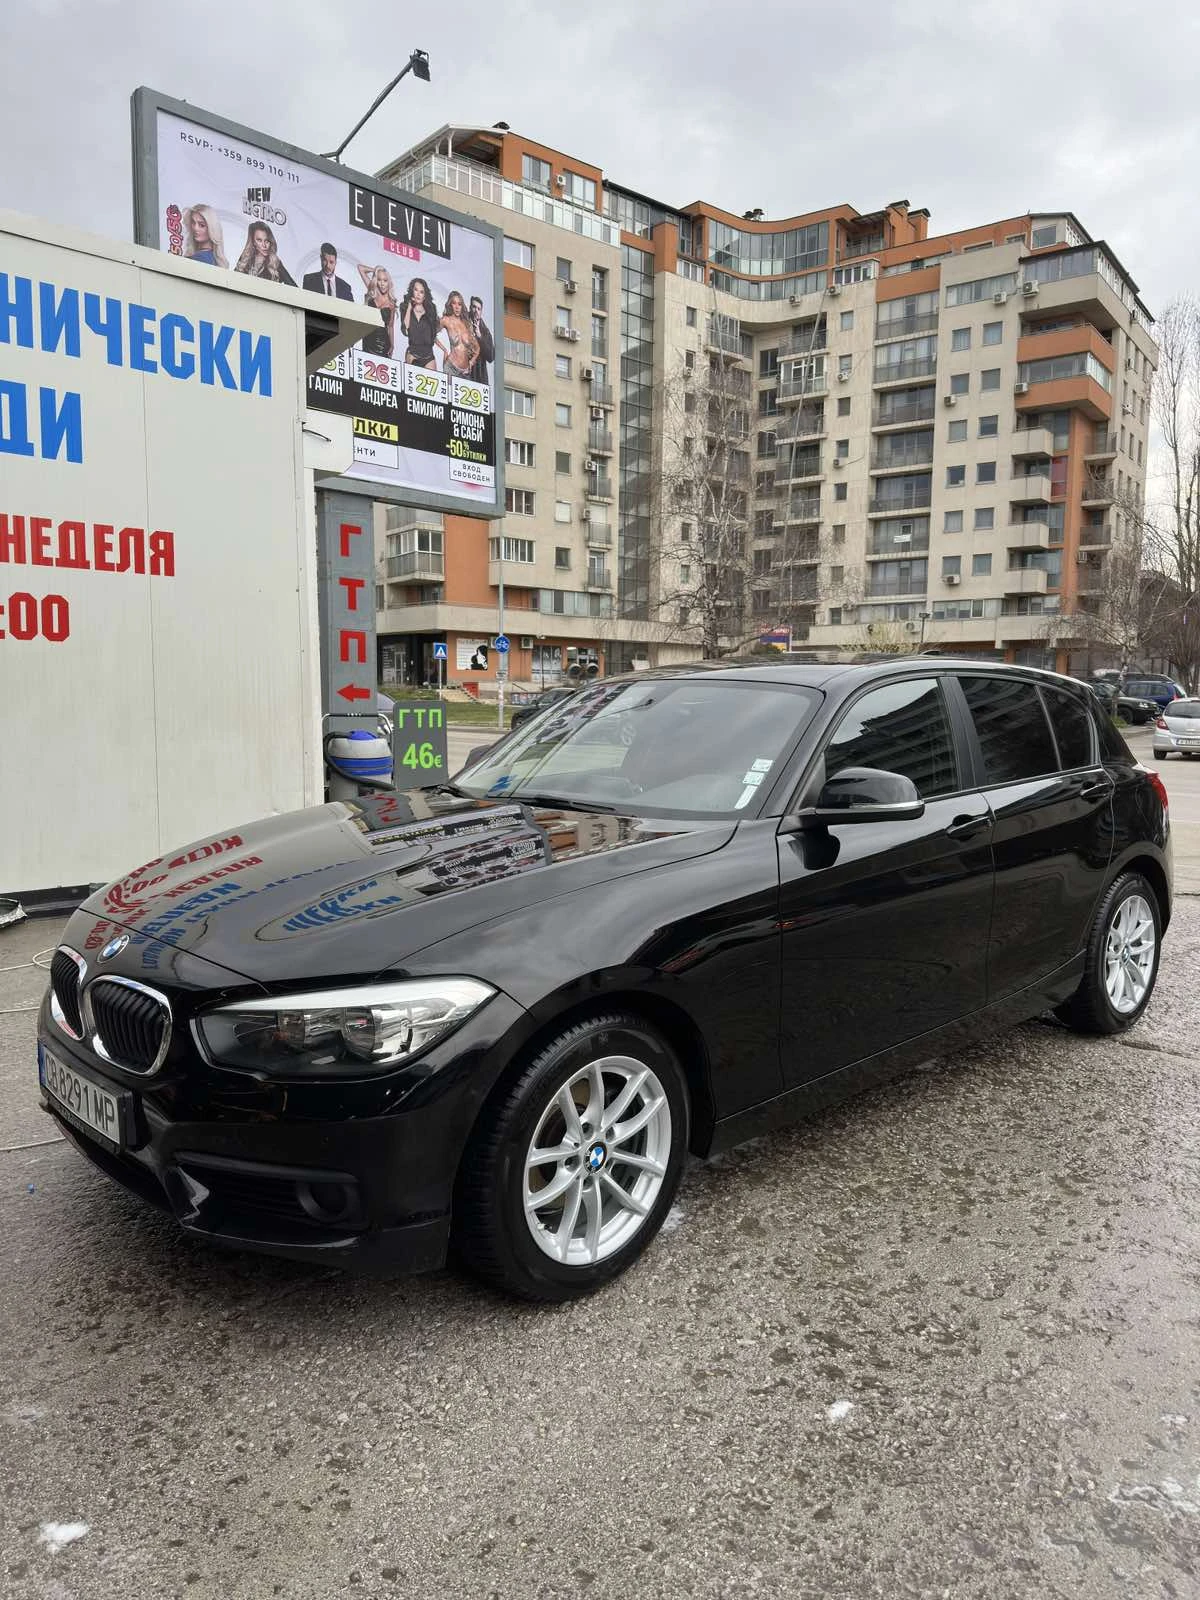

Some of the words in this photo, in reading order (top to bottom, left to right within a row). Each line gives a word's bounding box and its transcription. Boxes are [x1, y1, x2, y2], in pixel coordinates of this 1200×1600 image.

[180, 132, 213, 151] RSVP:
[218, 147, 242, 161] +359
[246, 157, 265, 170] 899
[268, 165, 284, 177] 110
[287, 172, 300, 183] 111
[247, 187, 271, 202] NEW
[354, 188, 446, 253] ELEVEN
[390, 242, 414, 258] CLUB
[0, 272, 272, 398] НИЧЕСКИ
[363, 360, 390, 385] 26
[309, 374, 343, 396] ГАЛИН
[415, 374, 439, 397] 27
[460, 385, 482, 408] 29
[360, 386, 398, 409] АНДРЕА
[407, 398, 444, 420] ЕМИЛИЯ
[450, 409, 485, 430] СИМОНА
[453, 424, 460, 437] &
[461, 425, 483, 442] САБИ
[453, 470, 491, 482] СВОБОДЕН
[463, 463, 481, 473] ВХОД
[0, 513, 175, 577] НЕДЕЛЯ
[339, 524, 367, 664] ГТП
[399, 709, 442, 728] ГТП
[403, 743, 442, 769] 46€
